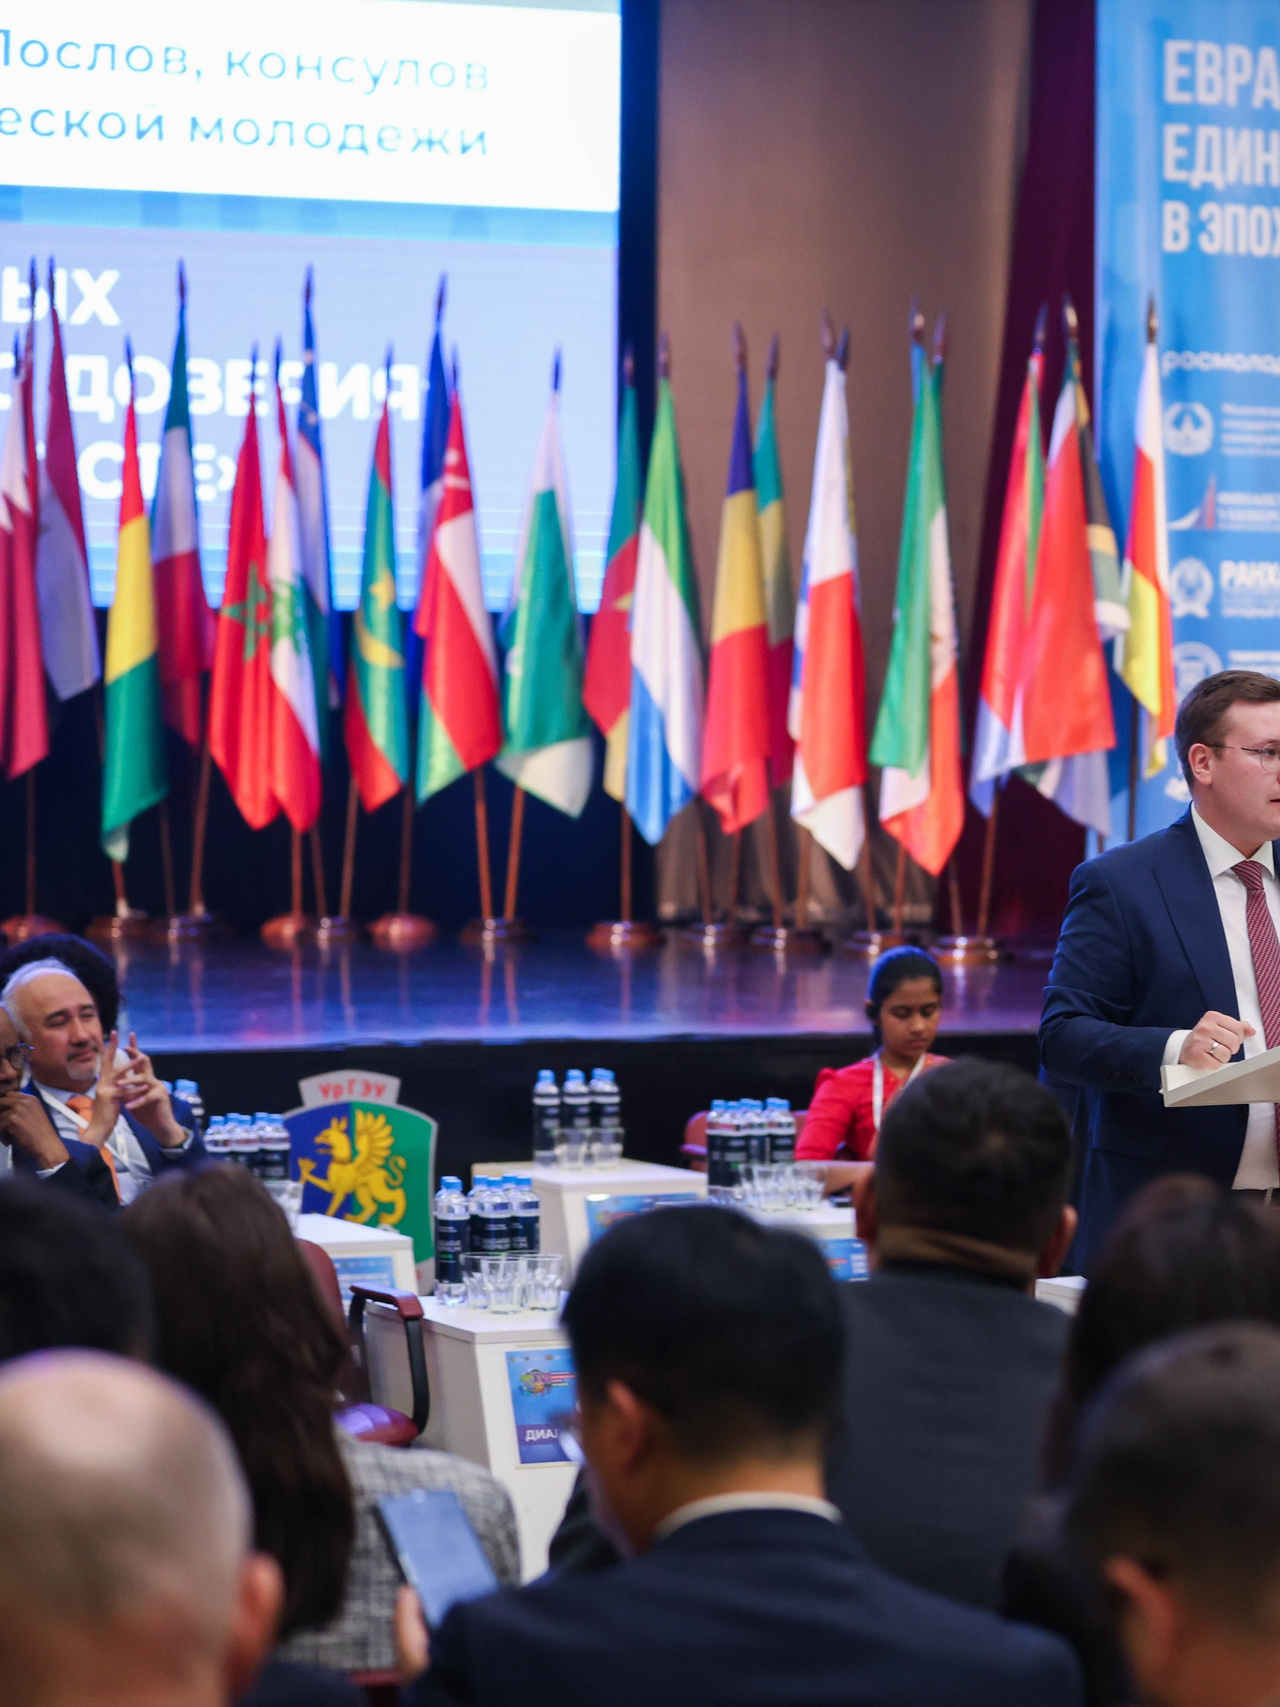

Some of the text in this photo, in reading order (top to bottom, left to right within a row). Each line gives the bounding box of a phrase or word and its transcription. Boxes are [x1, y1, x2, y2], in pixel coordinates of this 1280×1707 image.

[226, 49, 488, 94] консулов
[189, 115, 487, 156] молодежи
[1162, 201, 1190, 253] В
